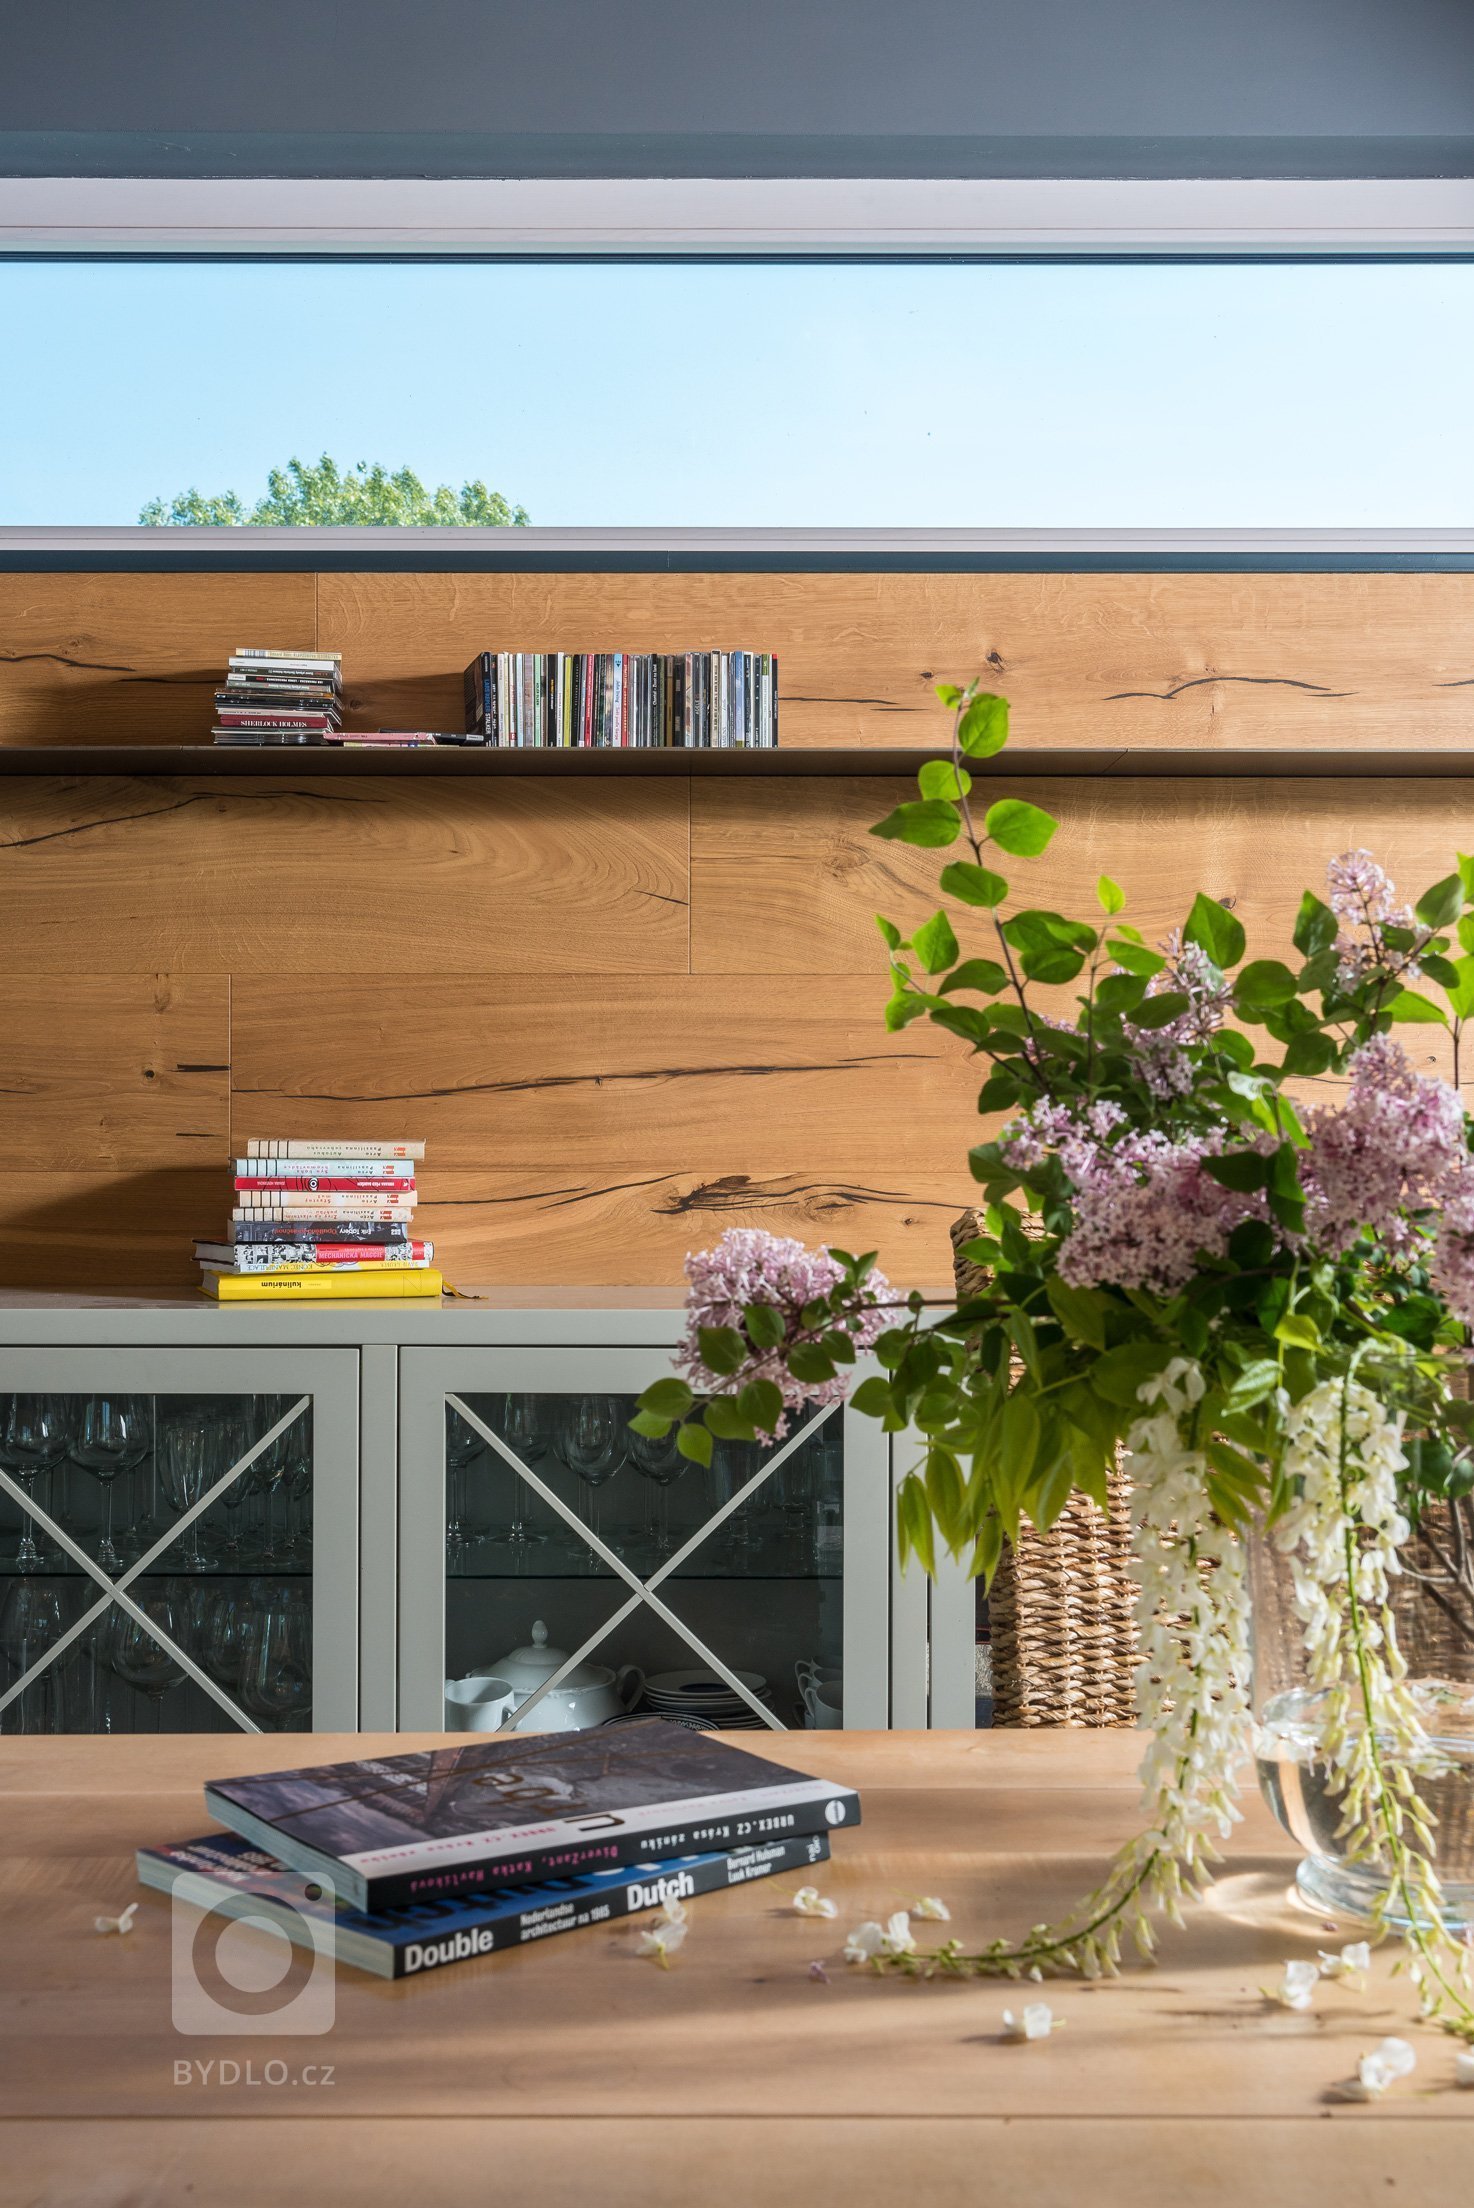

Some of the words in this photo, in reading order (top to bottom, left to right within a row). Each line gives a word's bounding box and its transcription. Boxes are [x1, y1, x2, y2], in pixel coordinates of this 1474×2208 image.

[339, 1227, 360, 1236] Tabery
[360, 1228, 372, 1236] Erik
[359, 1250, 384, 1259] MAGGIE
[261, 1280, 302, 1289] kulinárium
[691, 1824, 732, 1841] Krása
[735, 1813, 796, 1836] URBEX.CZ
[640, 1831, 686, 1851] zániku
[727, 1849, 758, 1870] Bernard
[757, 1844, 787, 1864] Hulsman
[491, 1859, 534, 1878] Katka
[745, 1861, 773, 1880] Kramer
[409, 1868, 485, 1894] Havlíková
[627, 1870, 696, 1912] Dutch
[520, 1902, 575, 1928] Nederlandse
[520, 1911, 578, 1942] architectuur
[577, 1911, 590, 1927] na
[404, 1927, 495, 1974] Double
